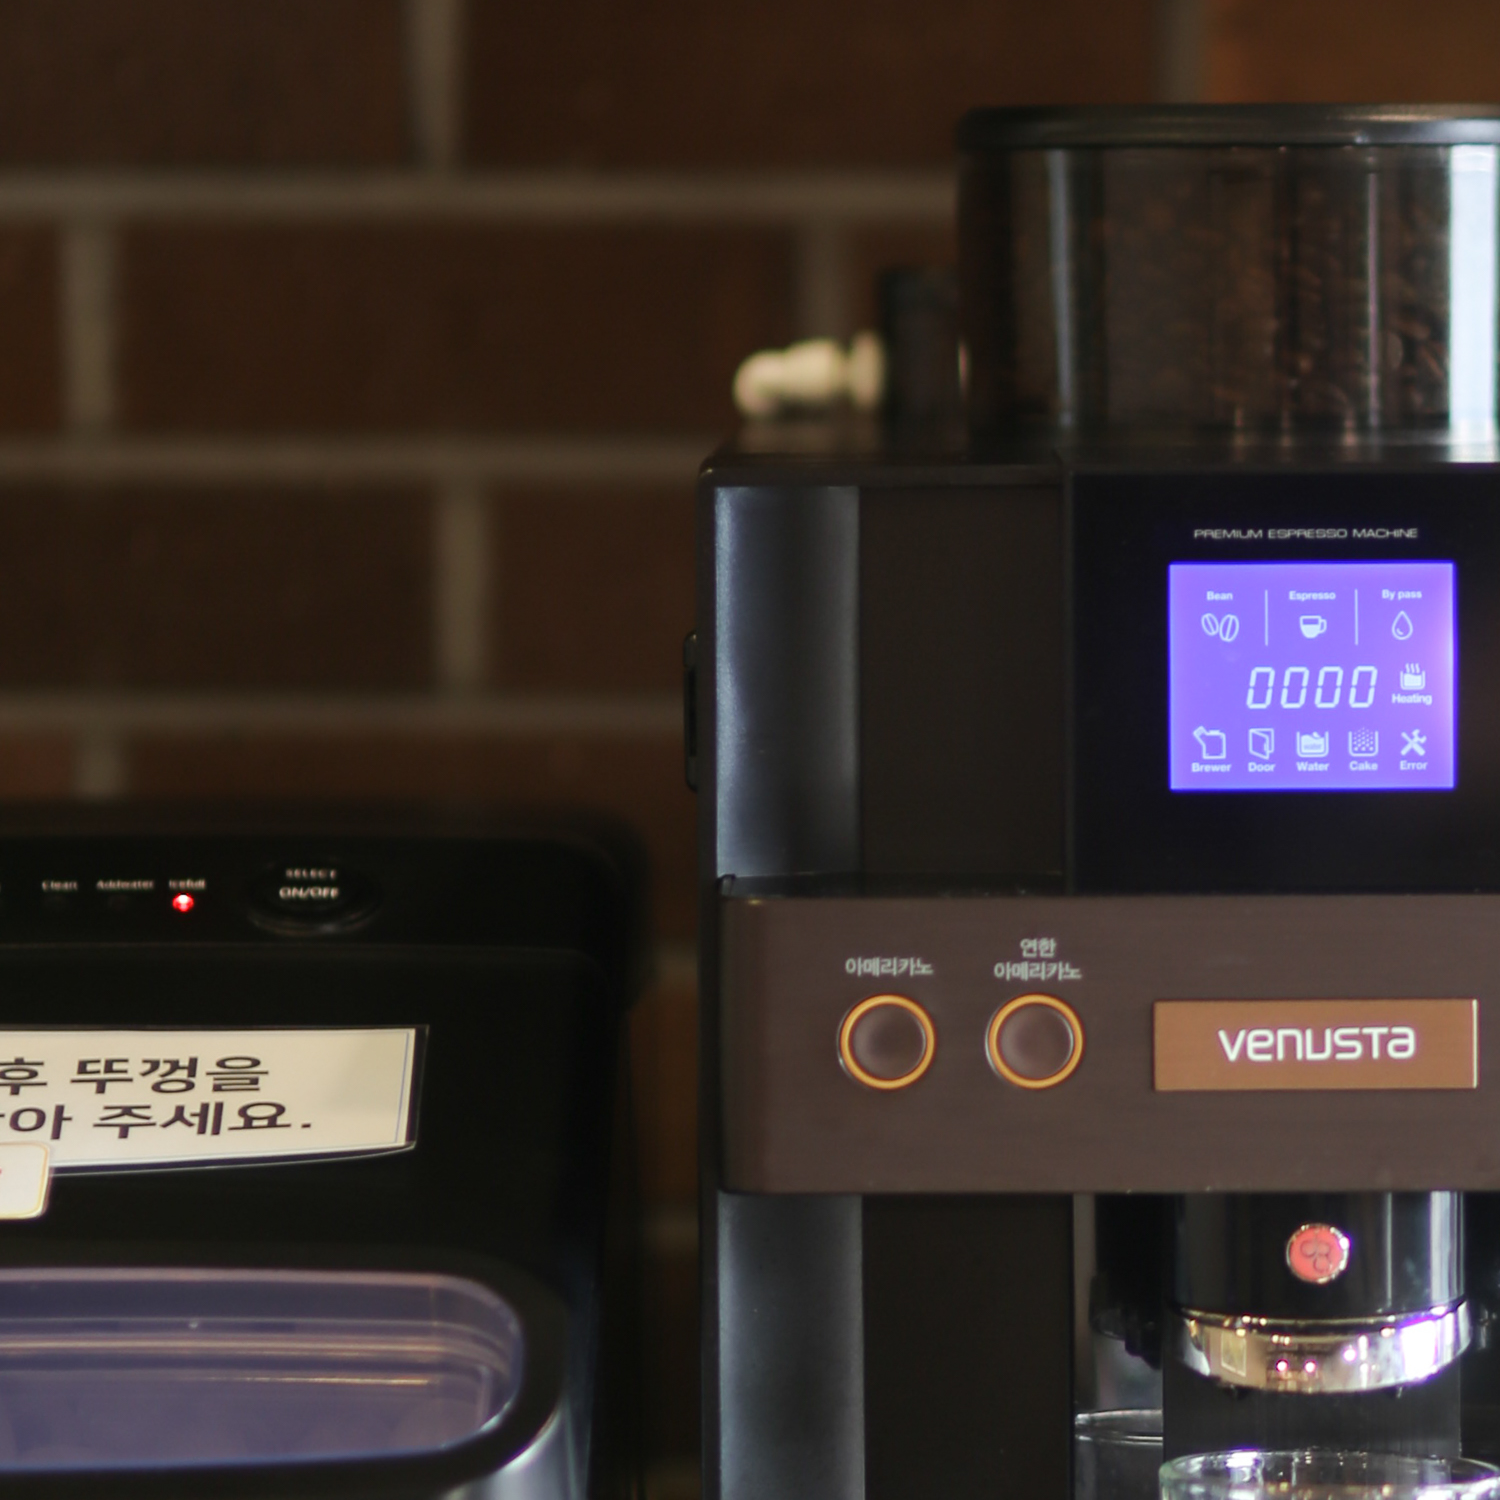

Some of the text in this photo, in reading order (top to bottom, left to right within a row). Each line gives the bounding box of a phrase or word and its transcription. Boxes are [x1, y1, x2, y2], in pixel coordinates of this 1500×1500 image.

[1194, 528, 1418, 539] PREMIUM ESPRESSO MACHINE
[1207, 591, 1233, 601] Bean
[1289, 591, 1336, 602] Espresso
[1382, 589, 1422, 601] By pass
[1246, 666, 1378, 709] 0000
[1392, 694, 1432, 706] Heating
[1192, 763, 1232, 773] Brewer
[1248, 762, 1276, 772] Door
[1296, 762, 1330, 772] Water
[1349, 761, 1378, 771] Cake
[1400, 760, 1428, 771] Error
[285, 868, 337, 879] SELECT
[278, 886, 339, 899] ON/OFF
[1019, 937, 1056, 958] 연한
[845, 957, 934, 977] 아메리카노
[993, 961, 1082, 981] 아메리카노
[0, 1055, 269, 1096] 후 뚜껑을
[0, 1101, 312, 1141] 아 주세요.
